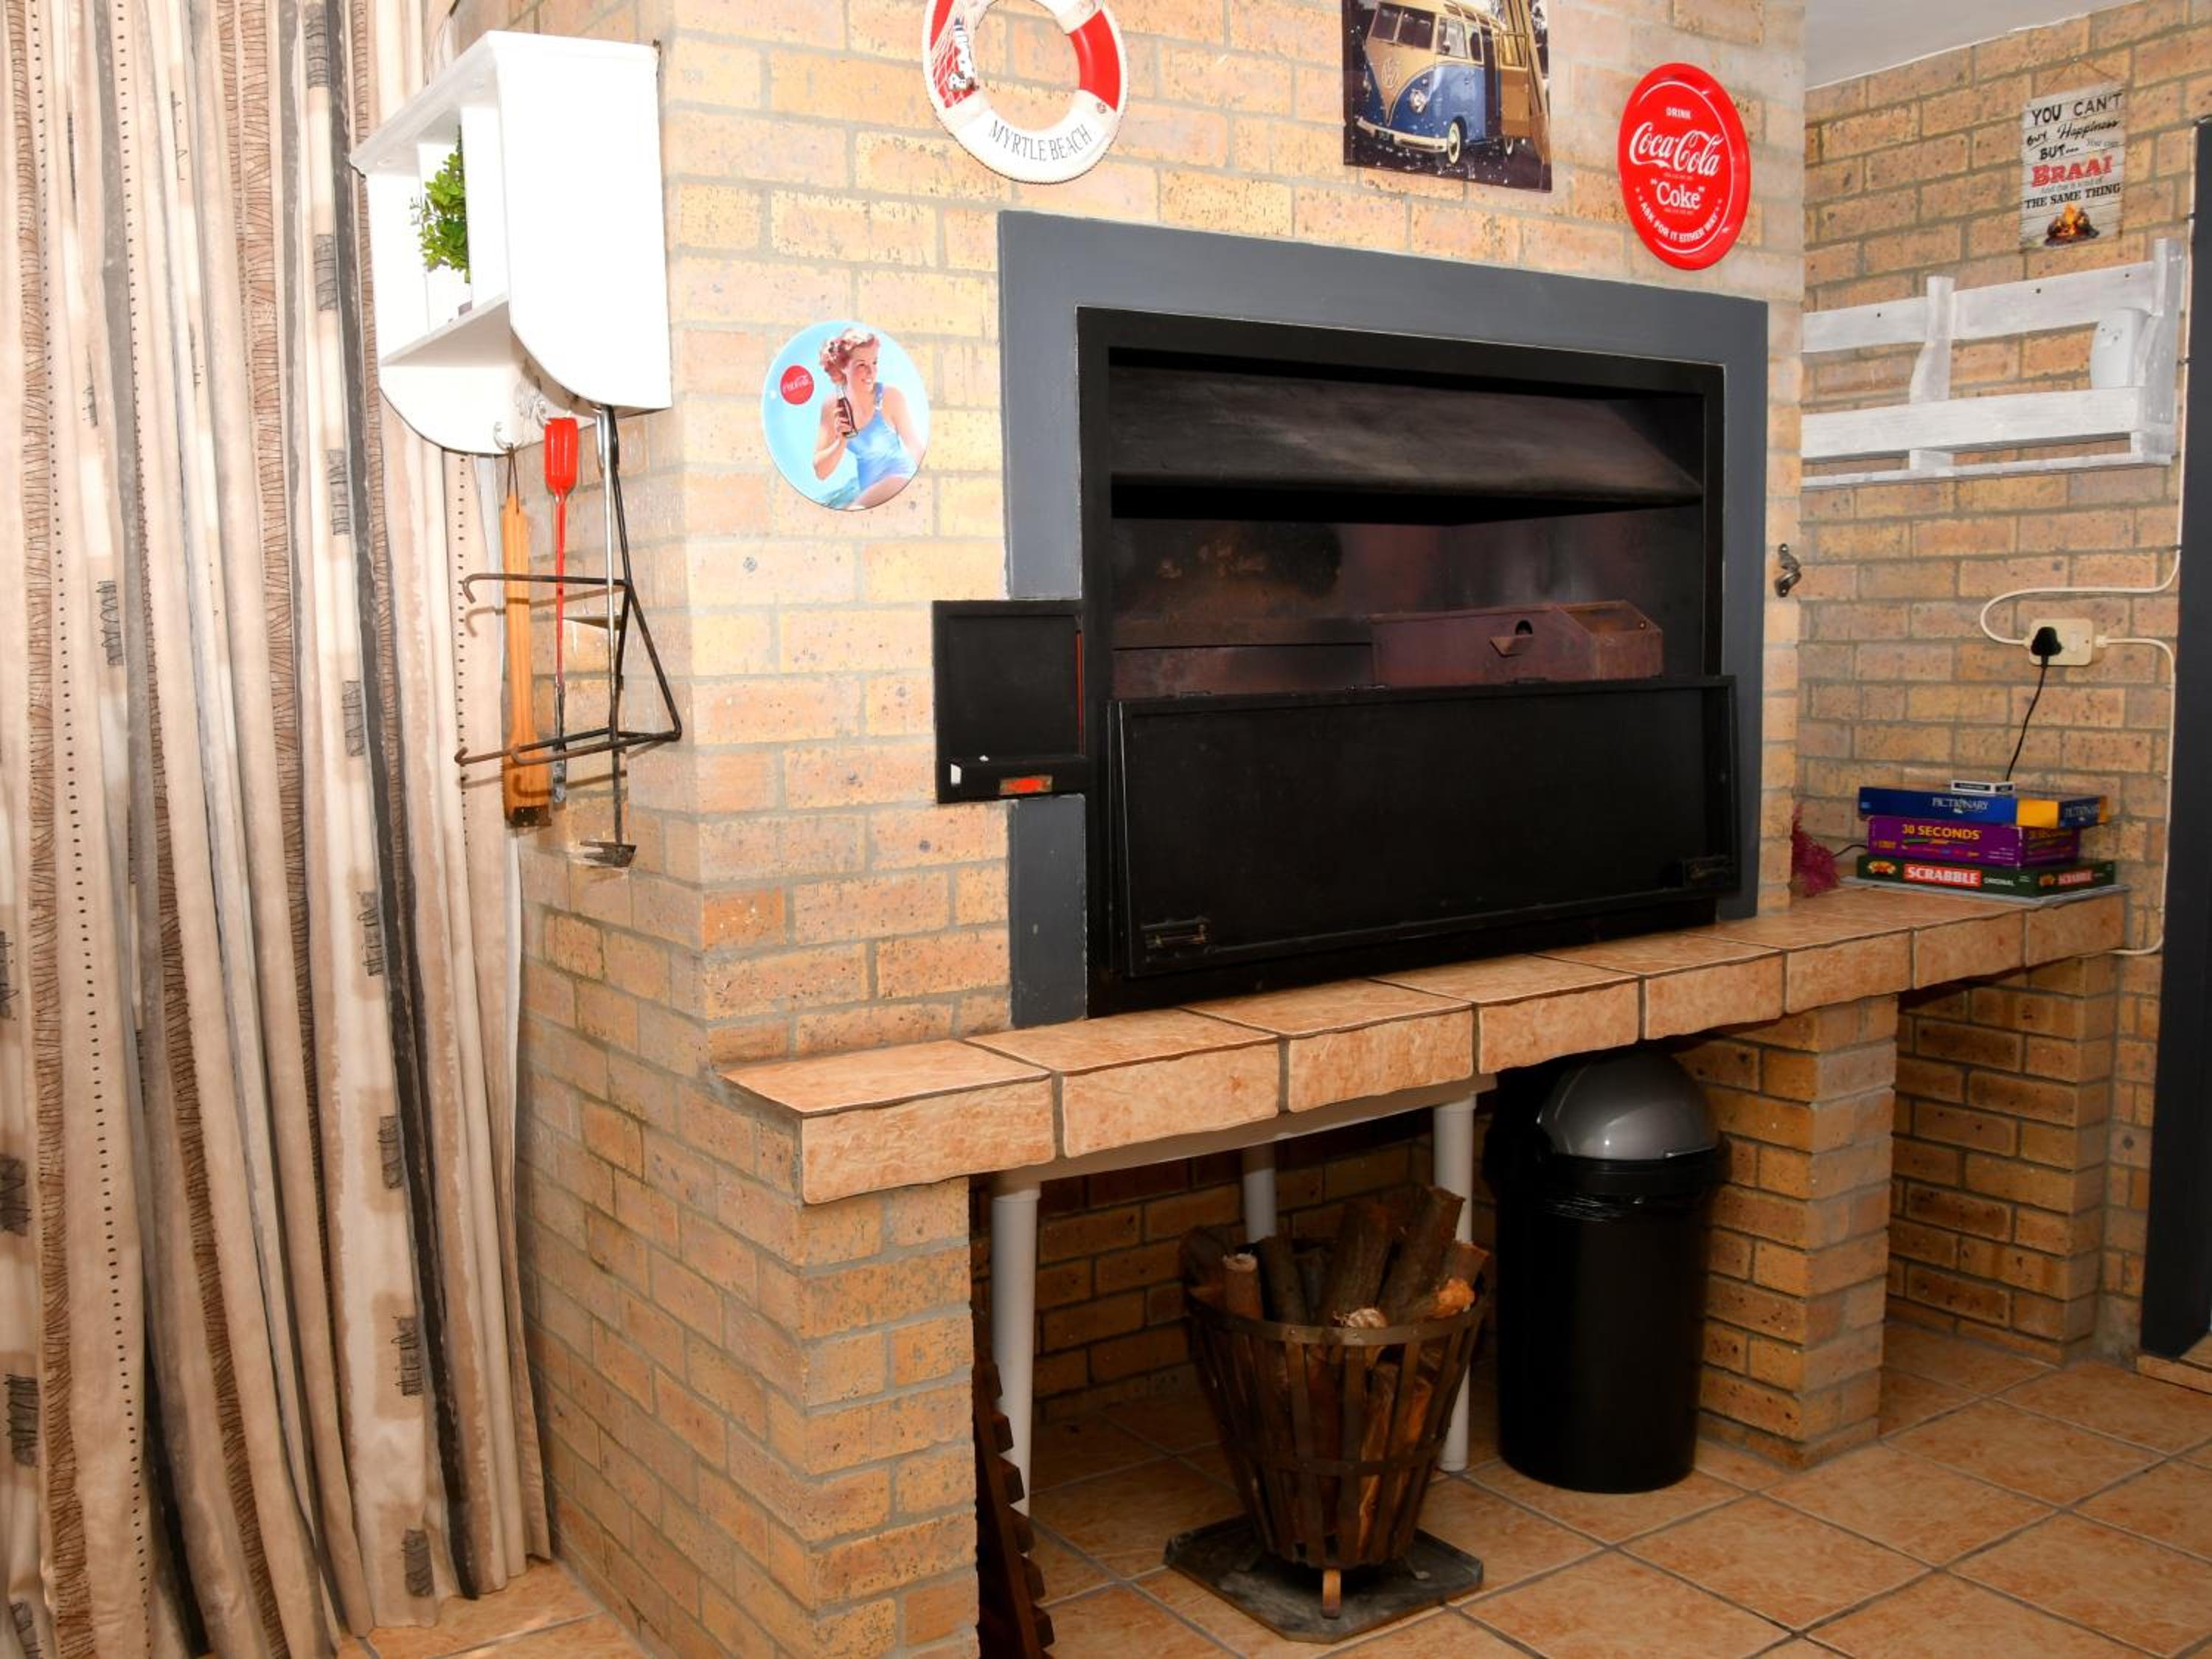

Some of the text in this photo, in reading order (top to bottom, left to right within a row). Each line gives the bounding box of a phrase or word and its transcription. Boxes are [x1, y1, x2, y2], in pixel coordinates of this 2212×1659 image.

[1665, 107, 1691, 119] DRINK
[2031, 93, 2123, 126] YOU CAN'T
[989, 120, 1092, 161] MYRTLE BEACH
[2056, 119, 2119, 140] Happiness
[1629, 122, 1724, 177] Coca-Cola
[2031, 155, 2113, 188] BRAAI
[2025, 197, 2048, 209] THE
[2050, 189, 2081, 204] SAME
[2085, 183, 2121, 198] THING
[1654, 220, 1669, 237] FOR
[1902, 824, 1980, 841] 30 SECONDS
[1907, 865, 1979, 886] SCRABBLE
